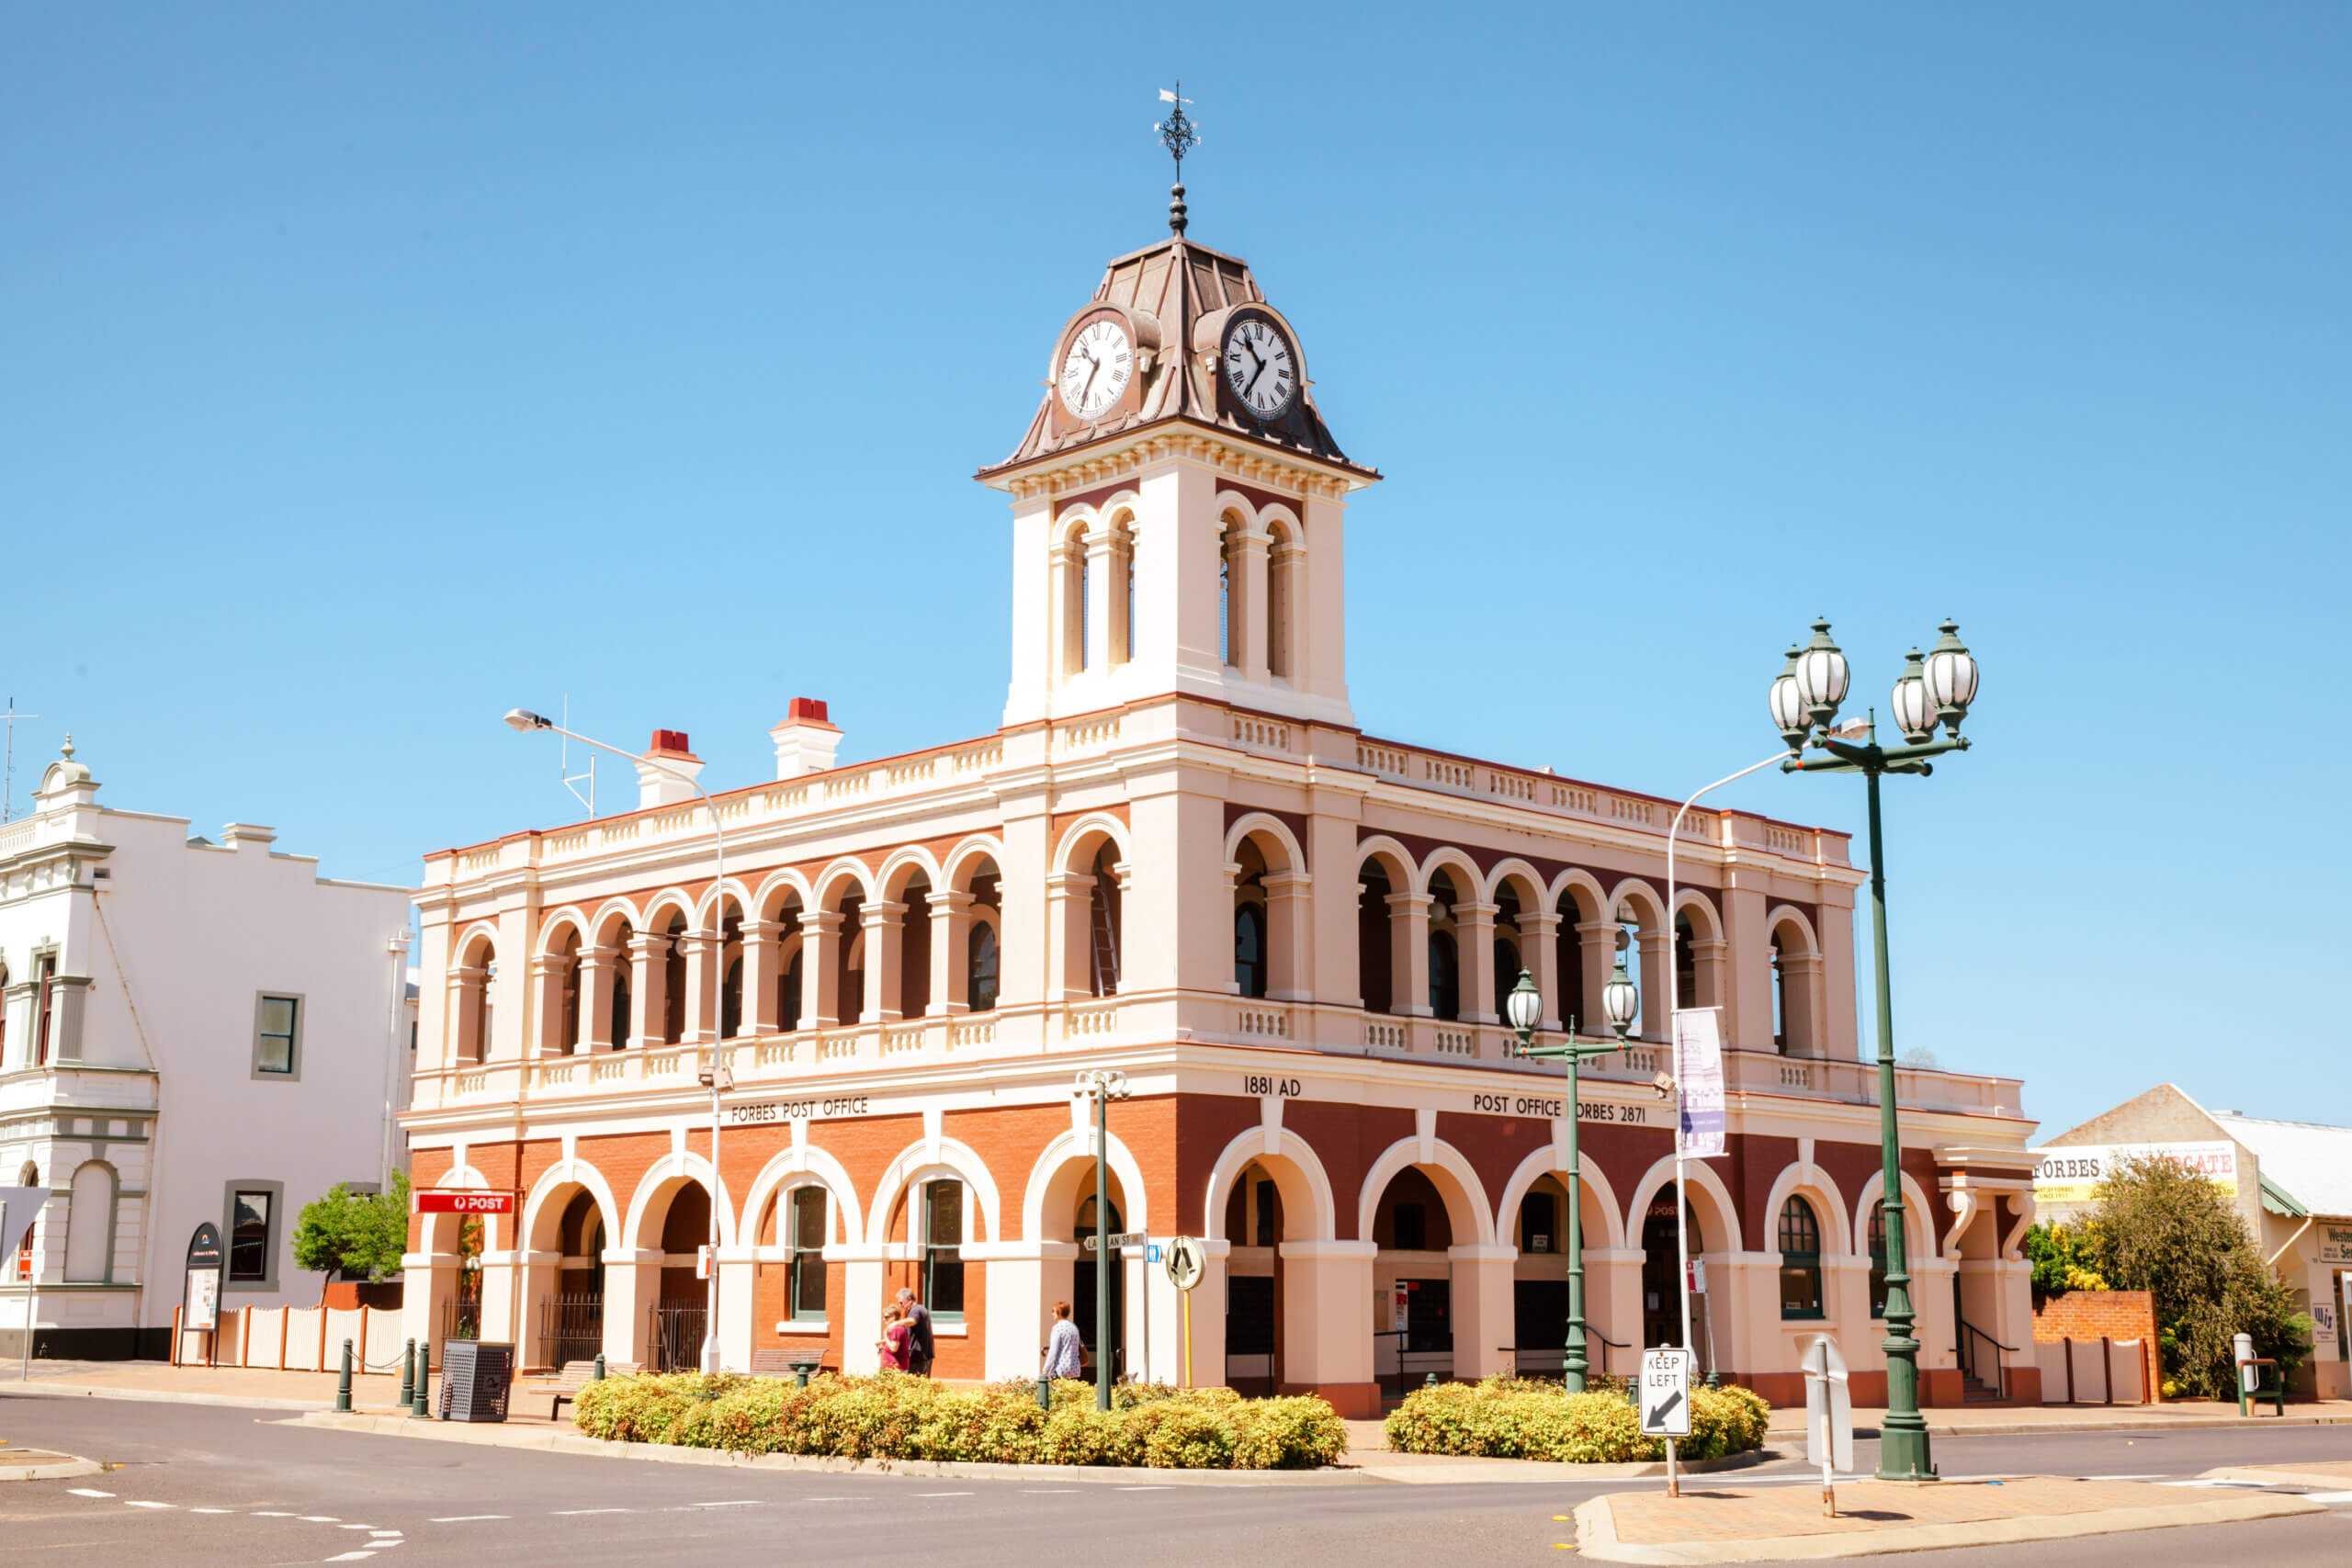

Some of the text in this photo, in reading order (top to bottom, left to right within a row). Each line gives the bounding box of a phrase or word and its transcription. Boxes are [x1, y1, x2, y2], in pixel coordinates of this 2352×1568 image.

[1245, 1076, 1301, 1096] 1881 AD
[731, 1097, 867, 1122] FORBES POST OFFICE
[1474, 1094, 1645, 1122] POST OFFICE ORBES 2871
[468, 1198, 503, 1210] POST
[1122, 1235, 1130, 1246] ST
[1648, 1357, 1679, 1370] KEEP
[1649, 1374, 1678, 1387] LEFT
